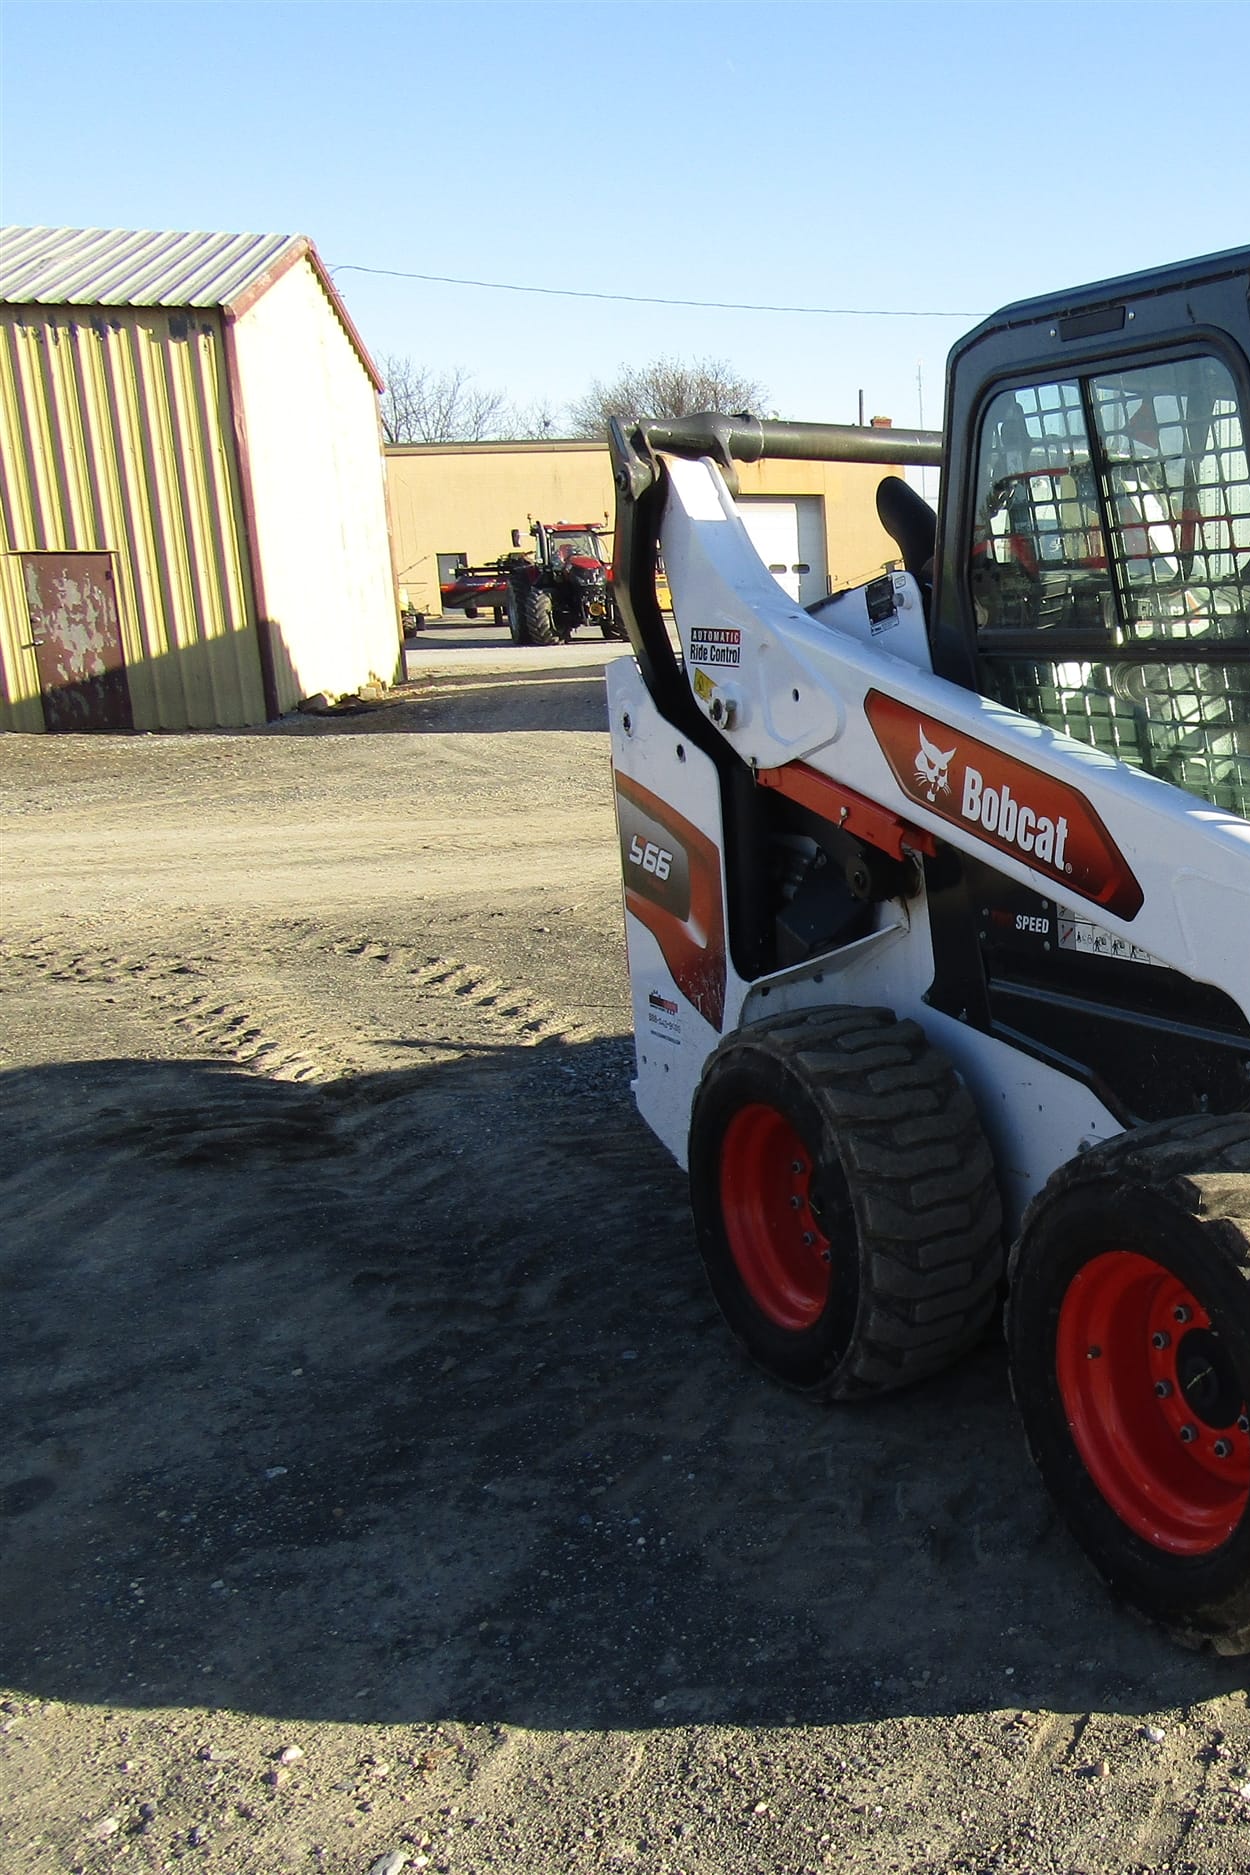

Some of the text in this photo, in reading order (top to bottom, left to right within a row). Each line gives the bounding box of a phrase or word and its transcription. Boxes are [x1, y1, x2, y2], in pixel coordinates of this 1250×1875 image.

[691, 630, 740, 644] AUTOMATIC
[690, 644, 741, 664] Ride Control
[962, 766, 1069, 871] Bobcat
[629, 834, 674, 881] S66
[1015, 914, 1050, 934] SPEED
